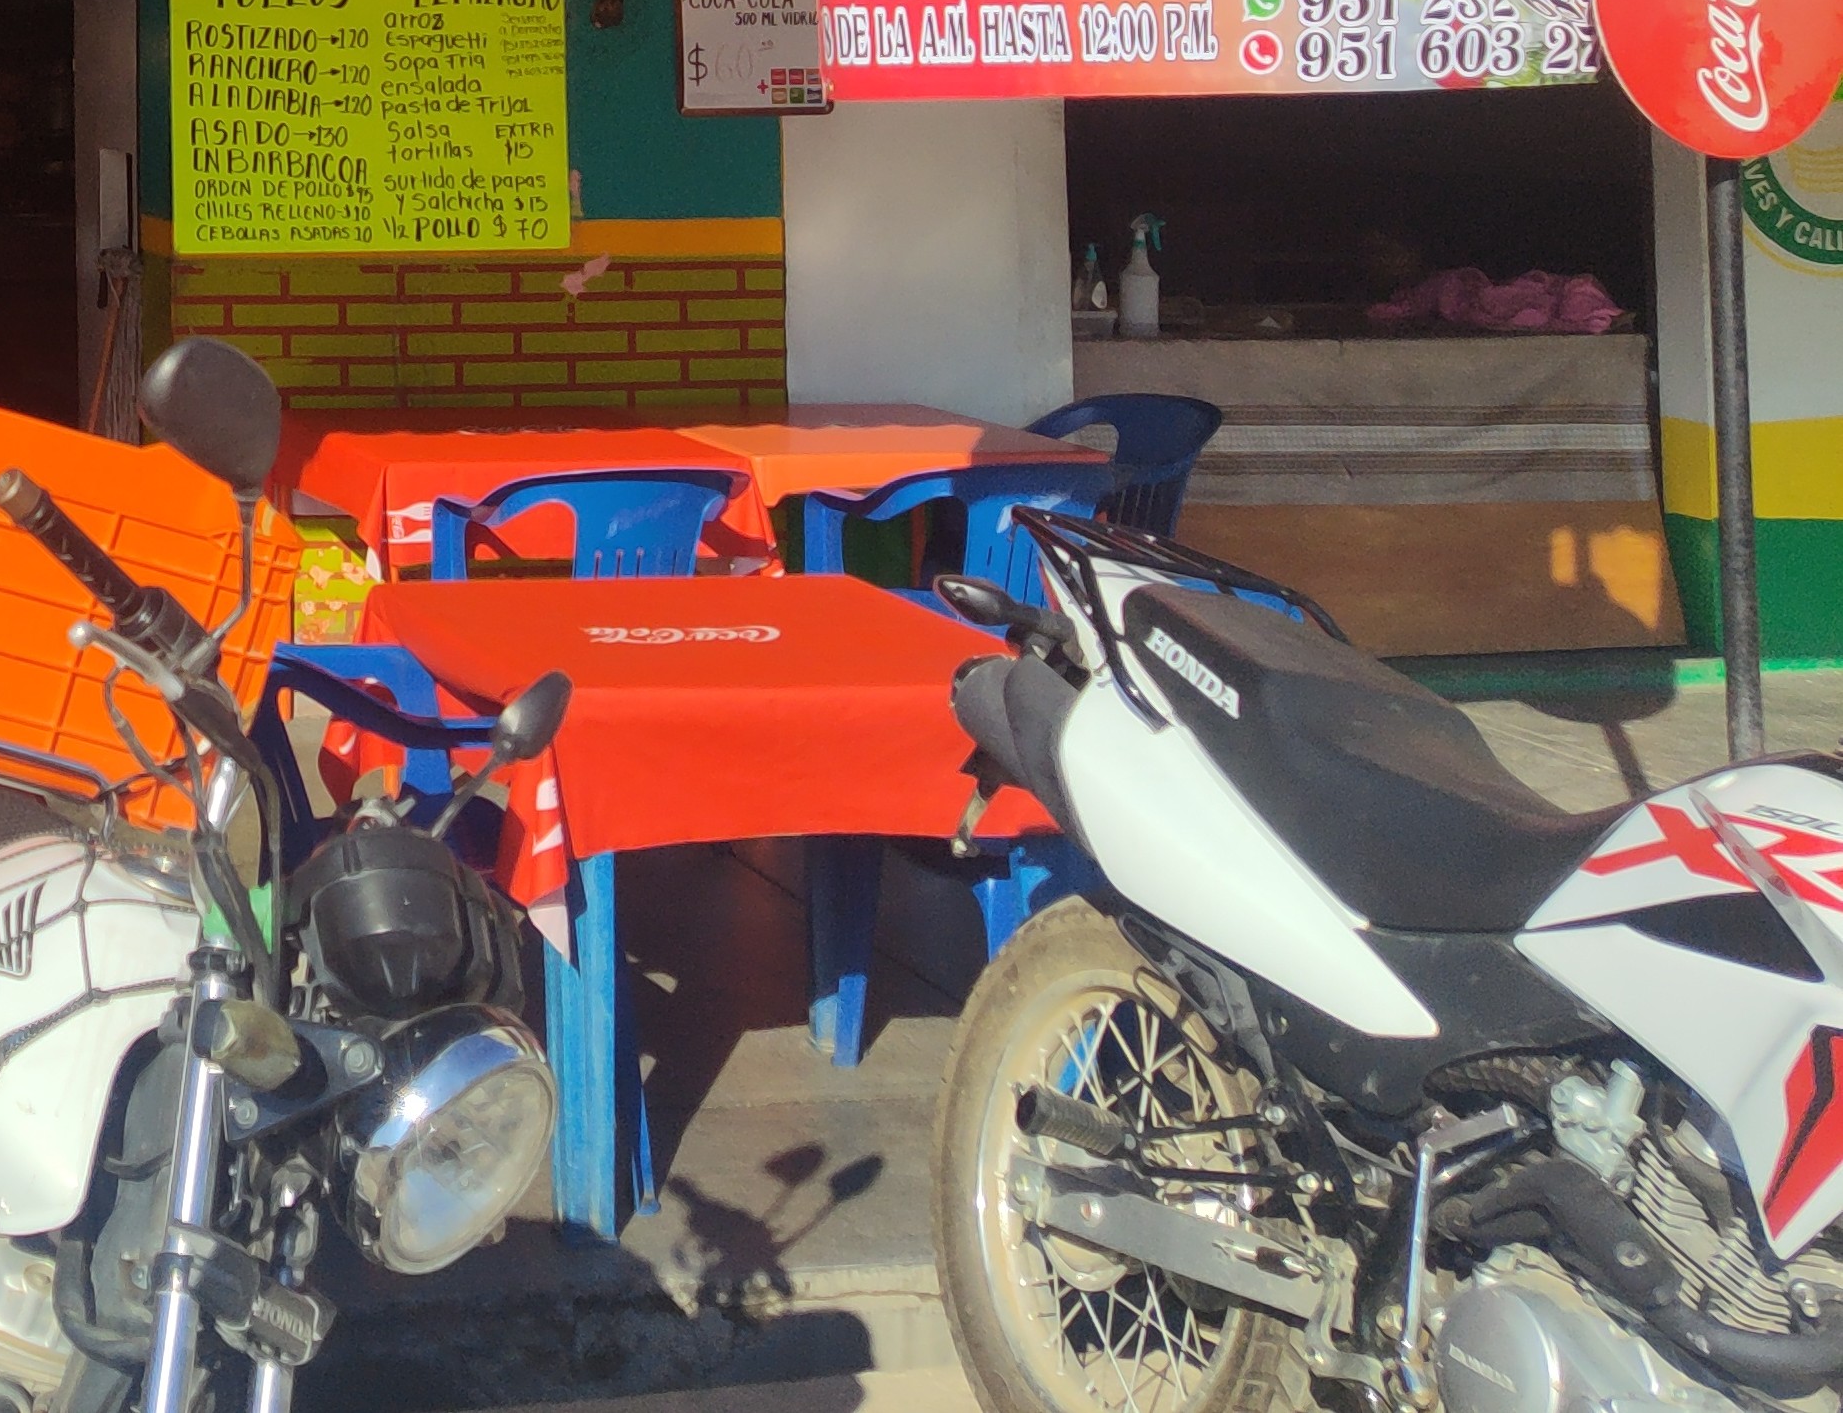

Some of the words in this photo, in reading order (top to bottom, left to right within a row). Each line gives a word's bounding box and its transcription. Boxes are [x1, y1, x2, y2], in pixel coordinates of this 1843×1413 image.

[761, 11, 778, 26] ML
[185, 19, 318, 53] ROSTIZADO
[380, 73, 483, 97] ensalada
[190, 117, 290, 147] ASADO
[494, 122, 555, 140] EXTRA
[262, 179, 289, 199] DE
[491, 174, 547, 194] papas
[1143, 626, 1241, 720] HONDA
